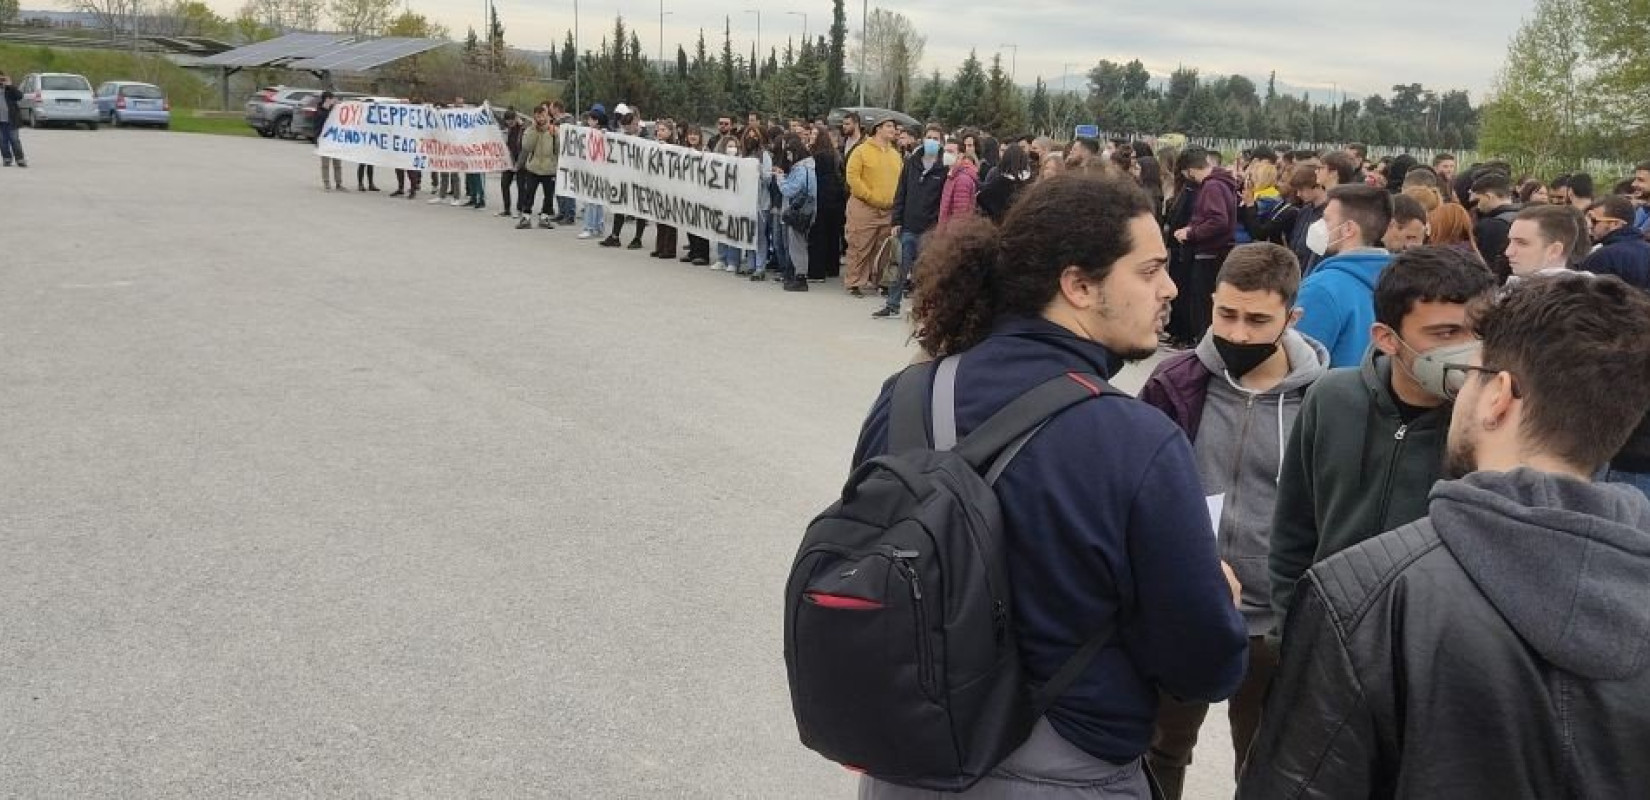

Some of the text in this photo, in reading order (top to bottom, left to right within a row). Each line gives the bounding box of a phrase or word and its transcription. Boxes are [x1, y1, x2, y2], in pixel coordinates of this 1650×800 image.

[367, 104, 424, 129] ΣΕΡΡΕΣ
[323, 125, 388, 150] ΜΕΝΟΥΜΕ
[392, 135, 417, 153] ΕΔΩ
[607, 138, 646, 172] ΣΤΗΝ
[648, 146, 739, 193] ΚΑΤΑΡΓΗΣΗ
